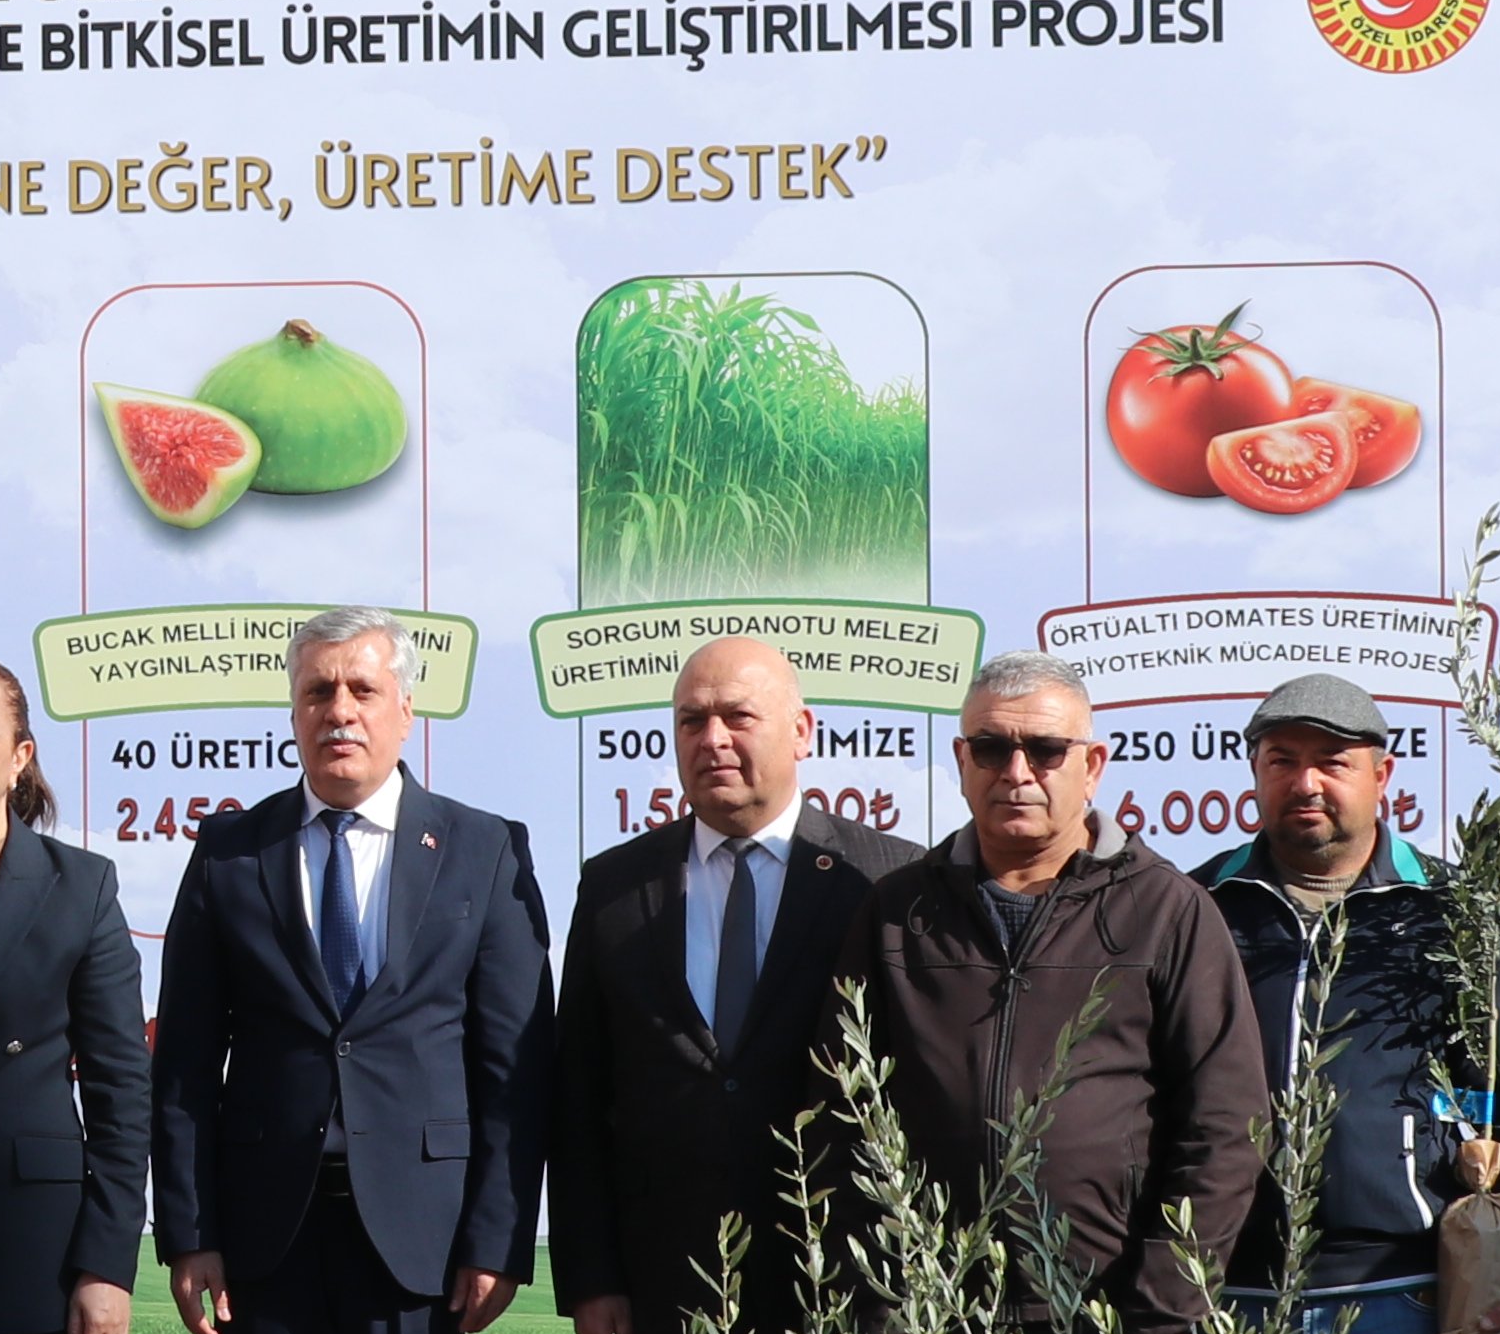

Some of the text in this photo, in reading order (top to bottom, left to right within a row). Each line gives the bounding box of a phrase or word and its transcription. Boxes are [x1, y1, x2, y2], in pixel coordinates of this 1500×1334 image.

[39, 7, 265, 71] BİTKİSEL
[280, 0, 545, 65] ÜRETİMİN
[1350, 15, 1394, 46] ÖZEL
[65, 140, 293, 223] DEĞER,
[313, 136, 595, 213] ÜRETİME
[66, 625, 155, 657] BUCAK
[162, 616, 237, 644] MELLİ
[567, 615, 940, 651] SORGUM SUDANOTU MELEZİ
[1050, 613, 1180, 649] ÖRTÜALTI
[1186, 606, 1315, 631] DOMATES
[551, 650, 961, 689] ÜRETİMİNİ PROJESİ
[1069, 641, 1213, 680] BİYOTEKNİK
[1219, 640, 1353, 665] MÜCADELE
[111, 731, 298, 769] 40 ÜRETİC
[598, 728, 667, 761] 500
[1109, 729, 1177, 764] 250
